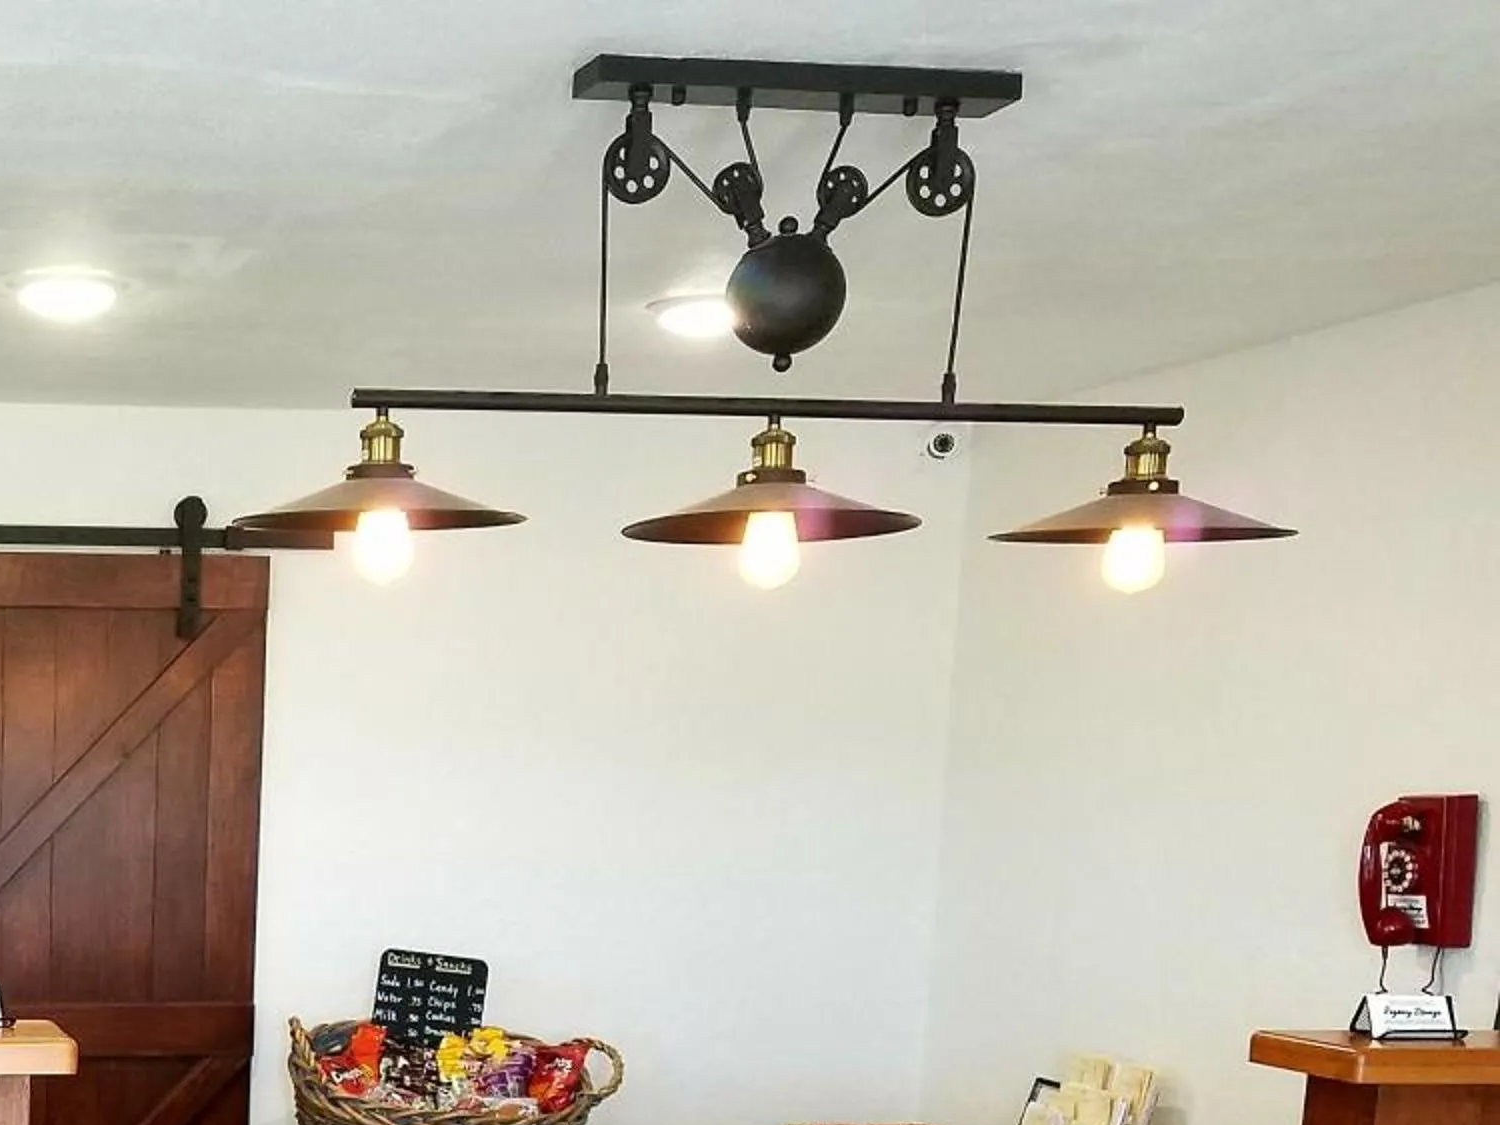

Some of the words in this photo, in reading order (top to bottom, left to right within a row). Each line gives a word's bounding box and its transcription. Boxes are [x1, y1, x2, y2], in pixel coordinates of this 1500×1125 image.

[388, 951, 421, 966] Drinks
[435, 957, 473, 972] Snacks
[380, 973, 401, 987] Soda
[429, 980, 458, 999] Candy
[377, 992, 402, 1003] Water
[428, 996, 456, 1012] Chips
[375, 1008, 398, 1022] Milk
[425, 1010, 455, 1024] Cookies
